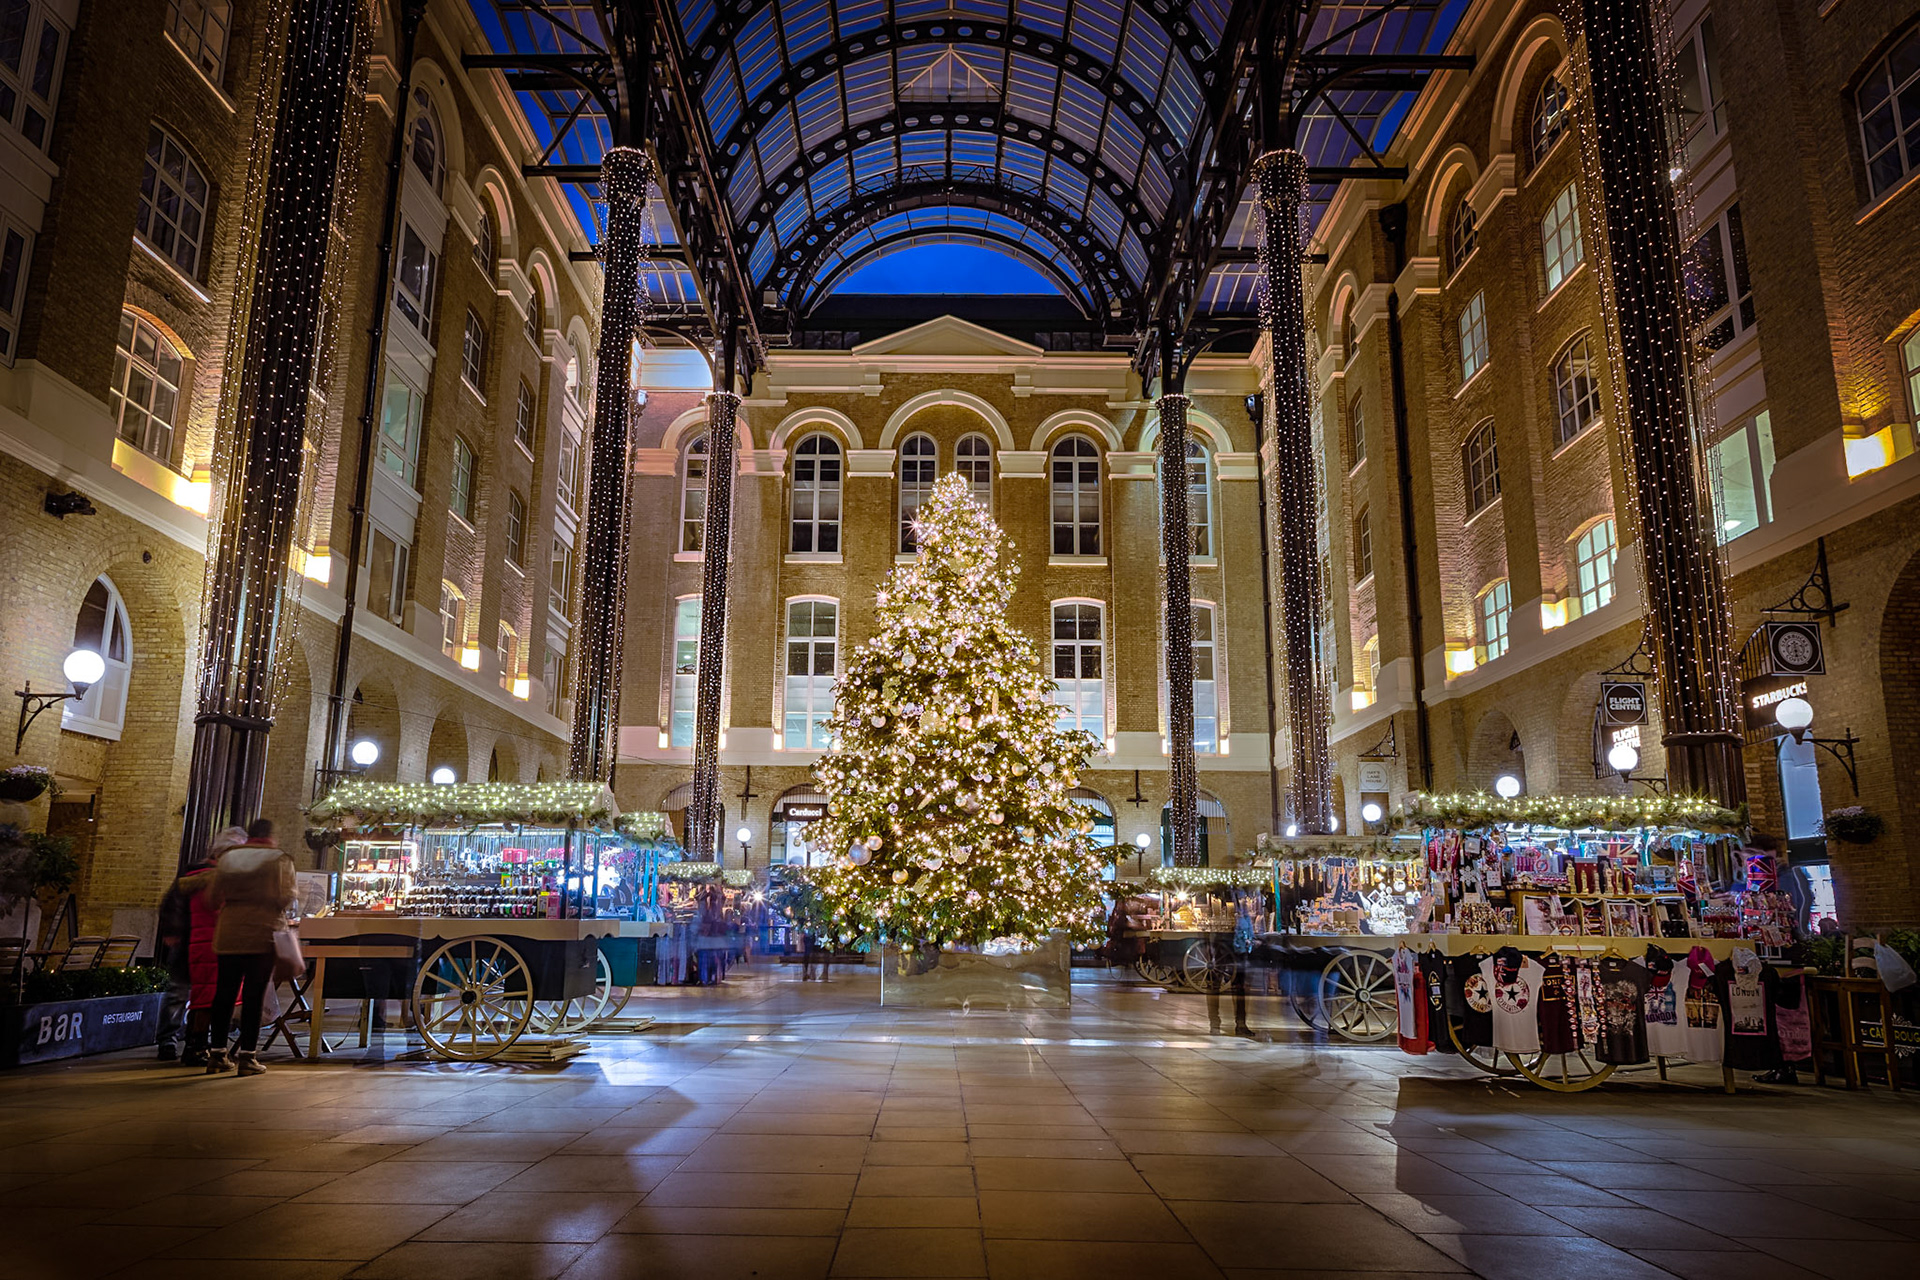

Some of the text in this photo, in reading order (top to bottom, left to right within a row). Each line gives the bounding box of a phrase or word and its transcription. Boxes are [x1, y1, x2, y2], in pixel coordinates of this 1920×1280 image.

[1609, 696, 1641, 704] FLIGHT
[1752, 681, 1808, 709] STARBUCKS
[1609, 703, 1643, 711] CENTRE
[1612, 724, 1640, 744] FLIGHT
[788, 807, 823, 817] Carducci
[1645, 1010, 1678, 1023] LONDON
[1893, 1030, 1920, 1043] ROUG
